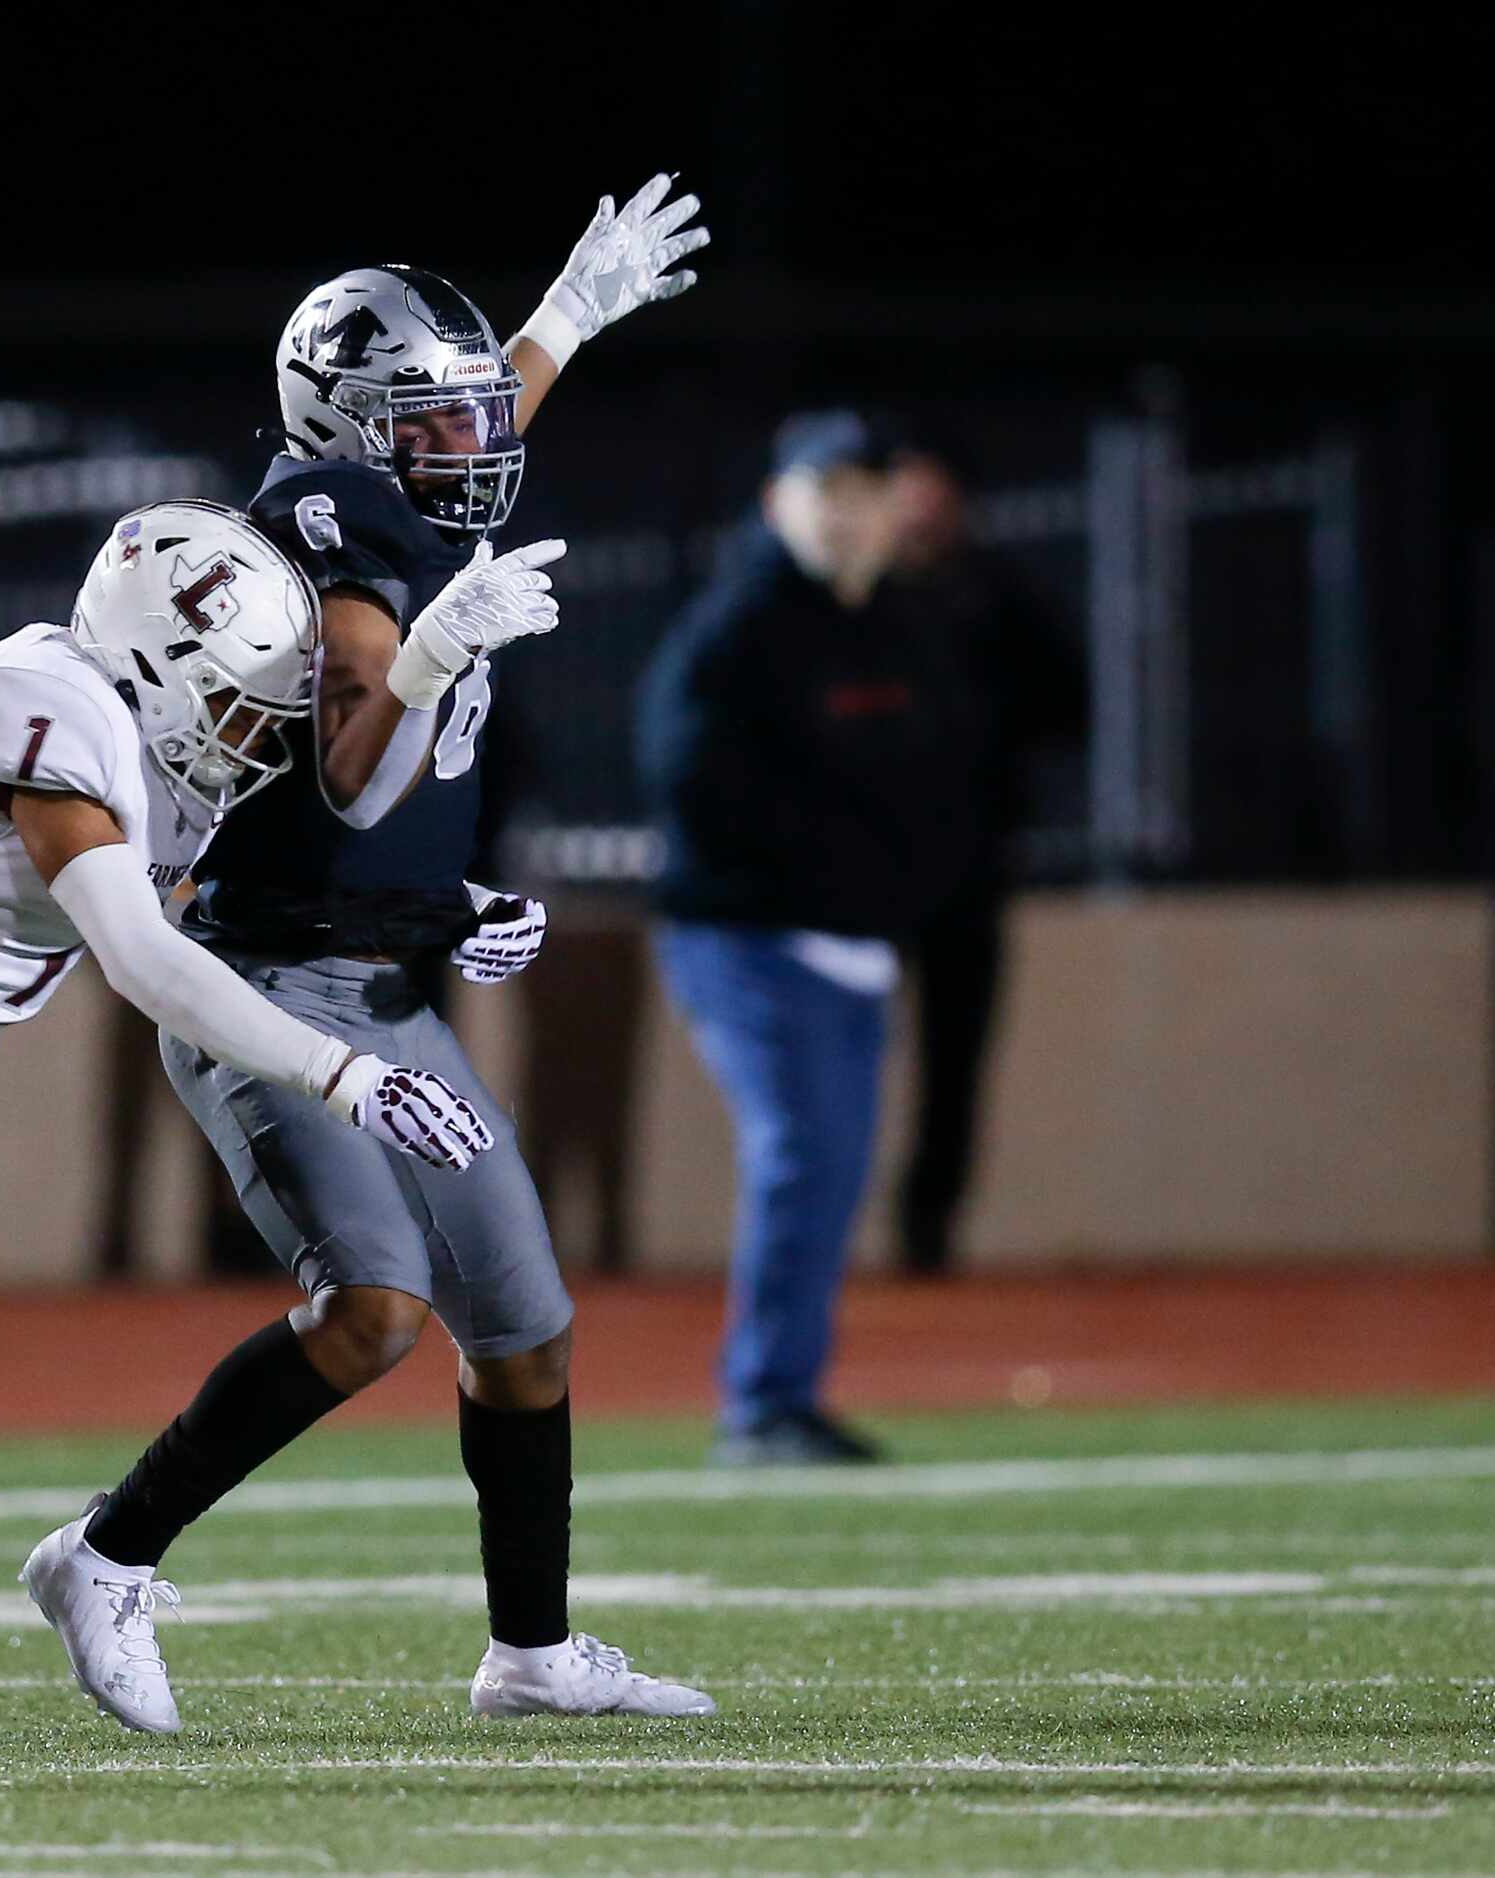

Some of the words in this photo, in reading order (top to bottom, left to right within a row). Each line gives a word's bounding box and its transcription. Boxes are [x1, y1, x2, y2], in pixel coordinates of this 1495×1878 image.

[294, 493, 343, 551] 6
[171, 560, 236, 634] L
[17, 714, 55, 781] 1
